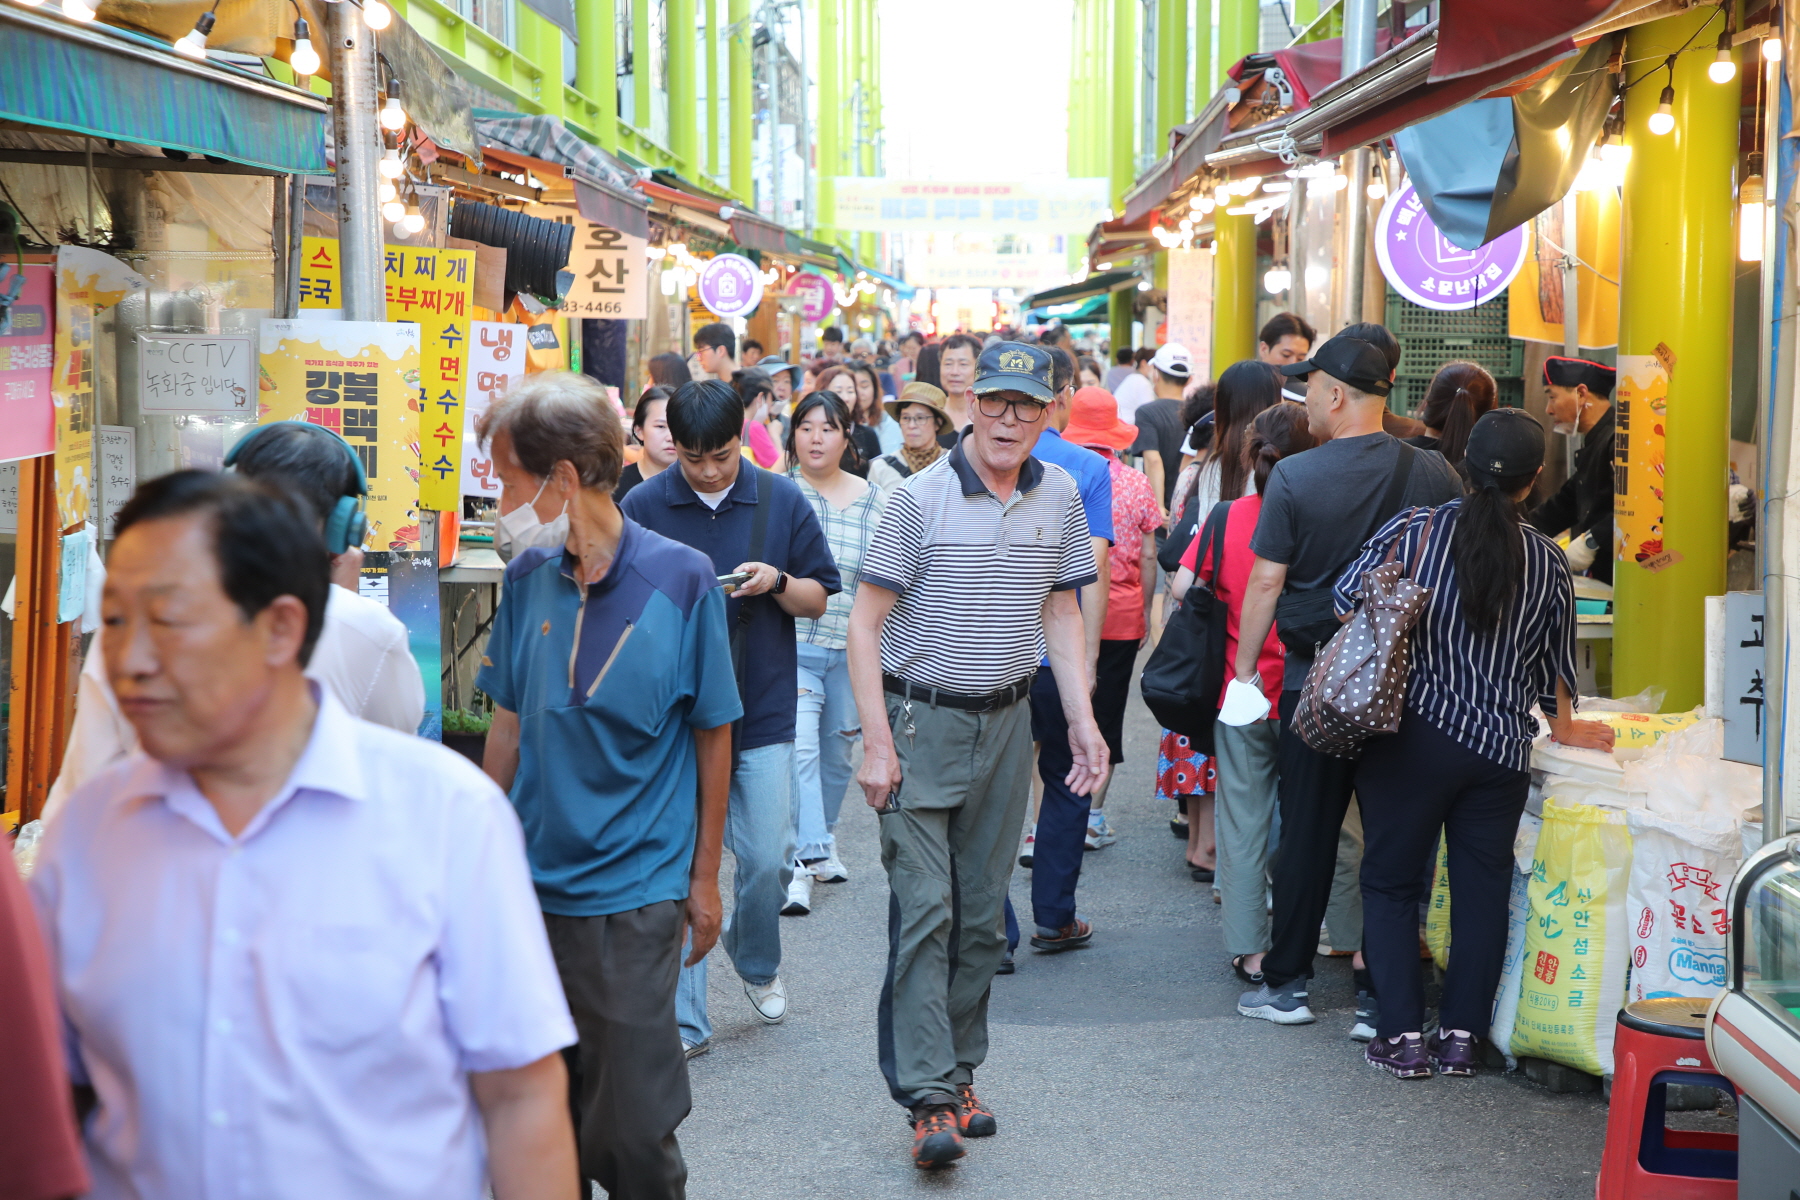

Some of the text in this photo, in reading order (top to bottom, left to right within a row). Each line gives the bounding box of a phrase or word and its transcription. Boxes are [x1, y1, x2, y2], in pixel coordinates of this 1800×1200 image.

[168, 342, 236, 368] CCTV
[305, 370, 378, 406] 강북
[1675, 952, 1726, 976] Manna
